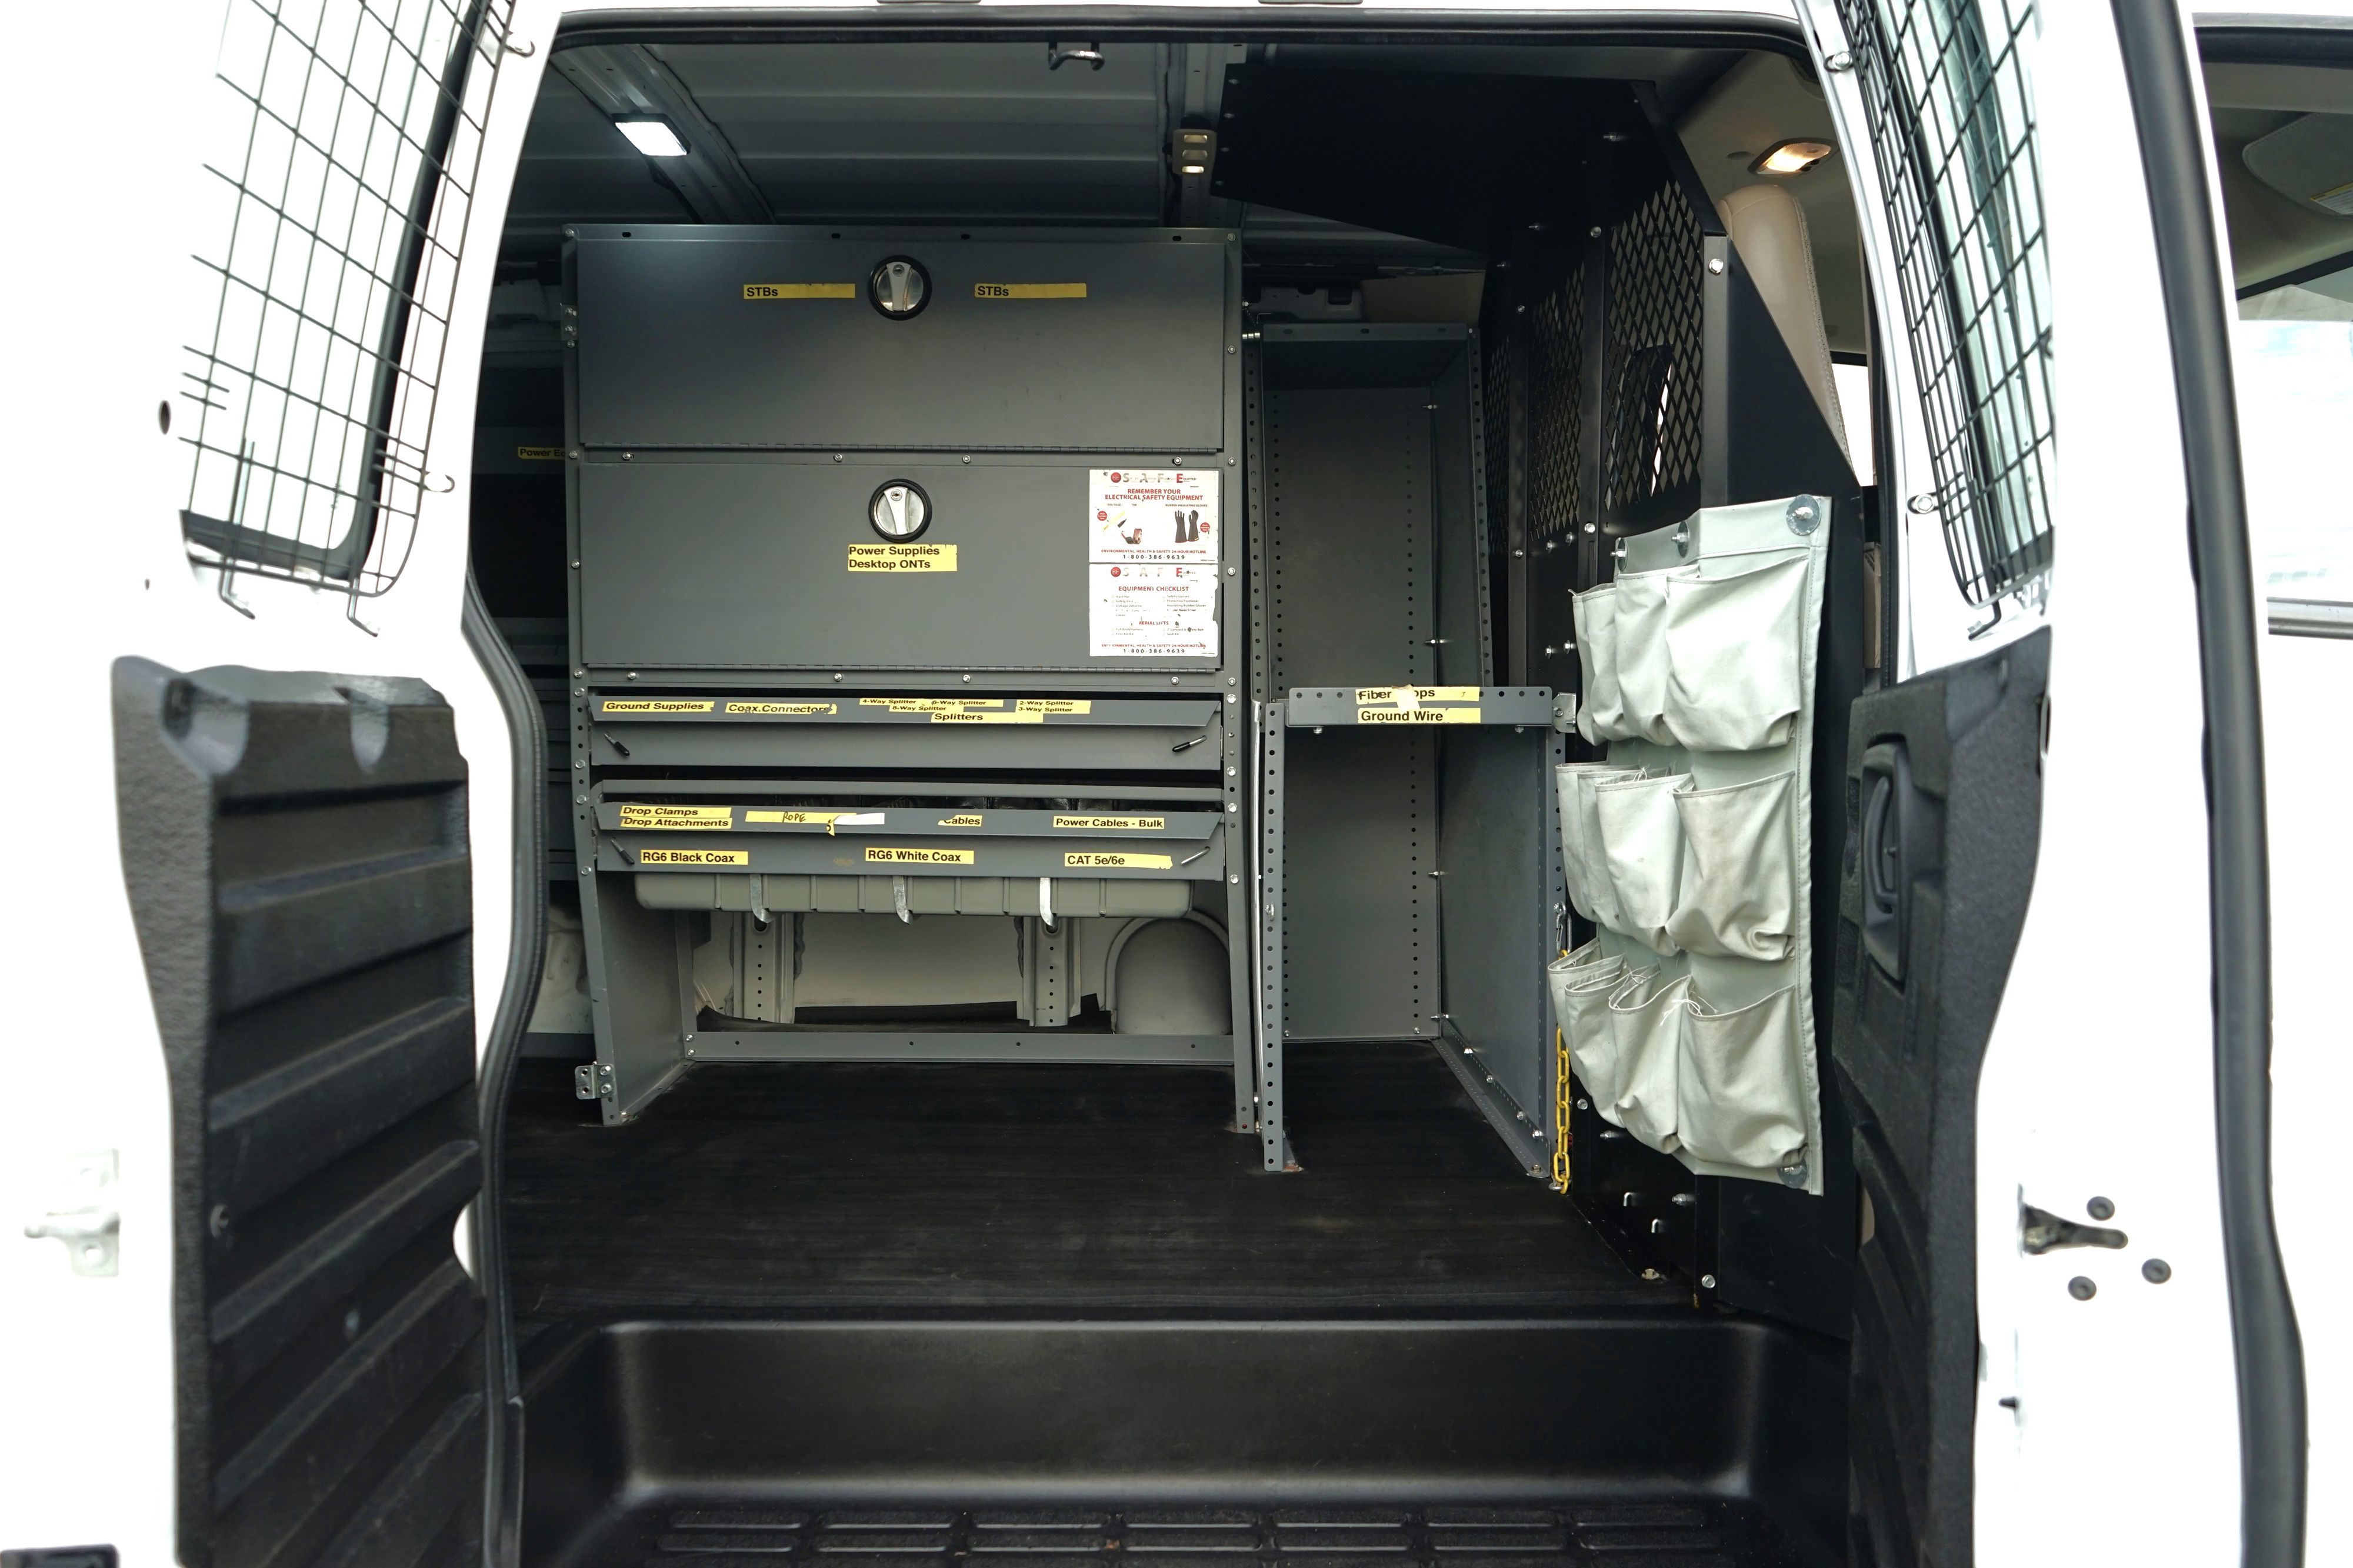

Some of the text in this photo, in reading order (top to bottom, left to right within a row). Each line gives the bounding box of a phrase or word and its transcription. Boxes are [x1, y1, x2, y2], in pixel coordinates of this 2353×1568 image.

[746, 287, 778, 297] STBs
[977, 286, 1009, 296] STBs
[849, 546, 940, 557] Power Supplies
[849, 559, 931, 570] Desktop ONTs
[1358, 690, 1392, 700] Fiber
[1361, 710, 1444, 721] Ground Wire
[623, 807, 698, 816] Drop Clamps
[624, 818, 652, 826] Drop
[1092, 819, 1128, 827] Cables
[1139, 819, 1163, 828] Bulk
[643, 852, 735, 862] RG6 Black Coax
[868, 850, 961, 862] RG6 White Coax
[1067, 855, 1125, 865] CAT 5e/6e
